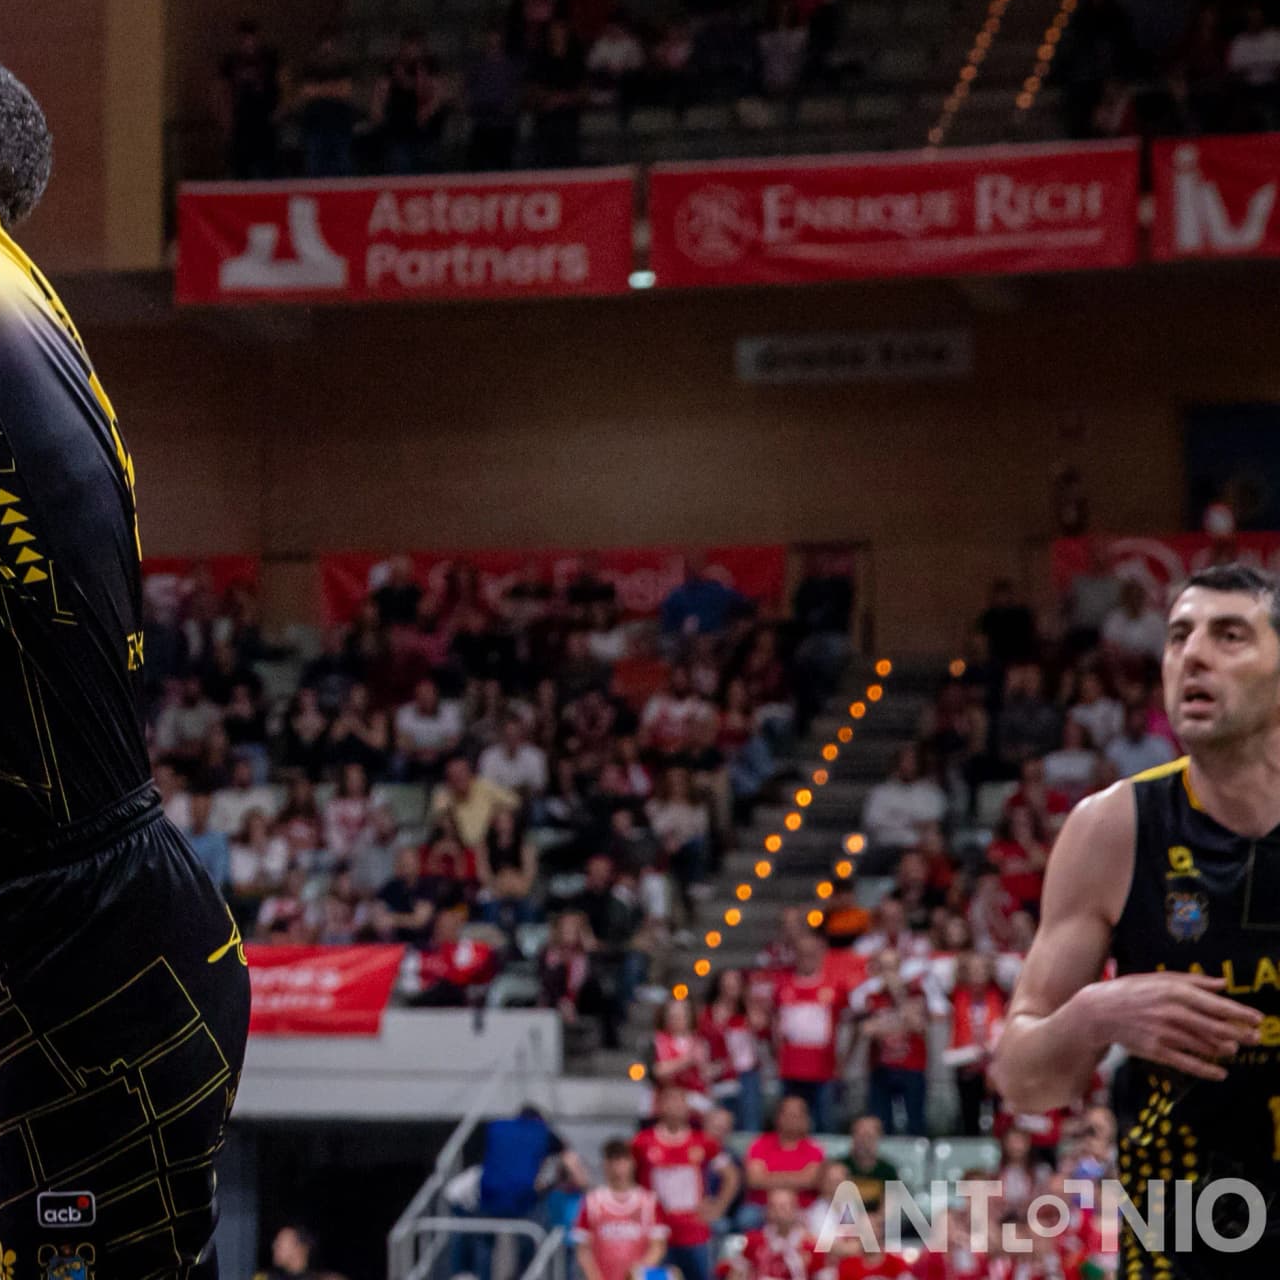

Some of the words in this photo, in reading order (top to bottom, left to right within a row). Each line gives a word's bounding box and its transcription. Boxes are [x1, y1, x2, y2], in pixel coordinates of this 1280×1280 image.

[366, 187, 563, 235] Asterra
[365, 241, 589, 289] Partners
[44, 1206, 82, 1223] acb
